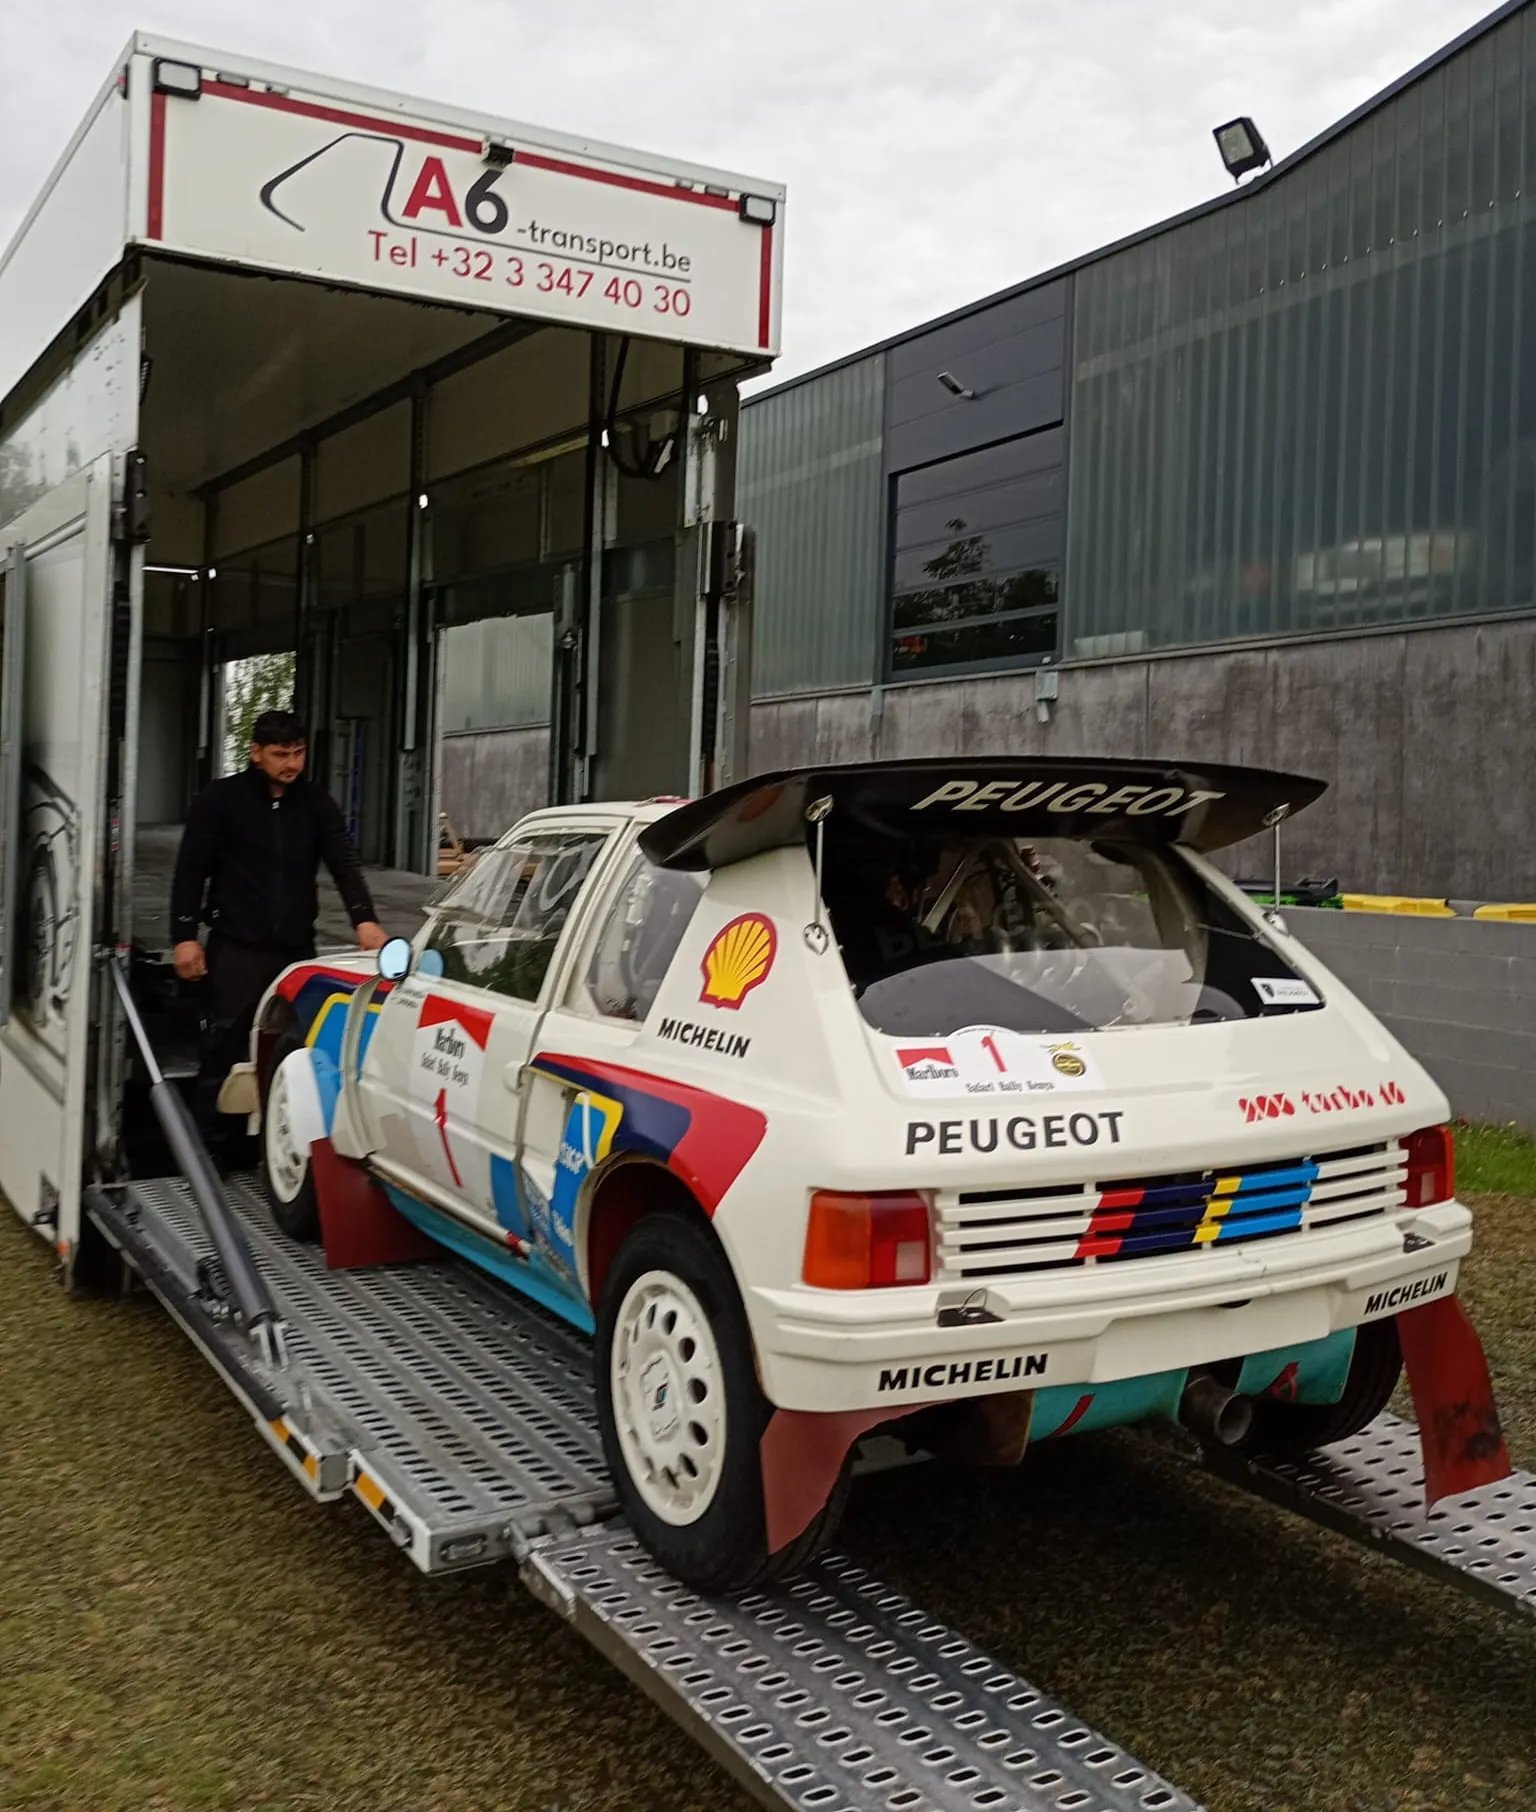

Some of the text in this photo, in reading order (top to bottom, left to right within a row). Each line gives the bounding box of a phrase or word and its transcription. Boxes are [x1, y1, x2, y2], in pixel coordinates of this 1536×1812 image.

[401, 156, 691, 273] A6 -transport.be
[368, 230, 690, 317] Tel +32 3 347 40 30
[909, 780, 1226, 816] PEUGEOT
[657, 1017, 751, 1058] MICHELIN
[981, 1035, 1008, 1073] 1
[907, 1064, 959, 1081] Marlboro
[905, 1111, 1123, 1155] PEUGEOT
[1364, 1271, 1448, 1315] MICHELIN
[877, 1353, 1049, 1392] MICHELIN
